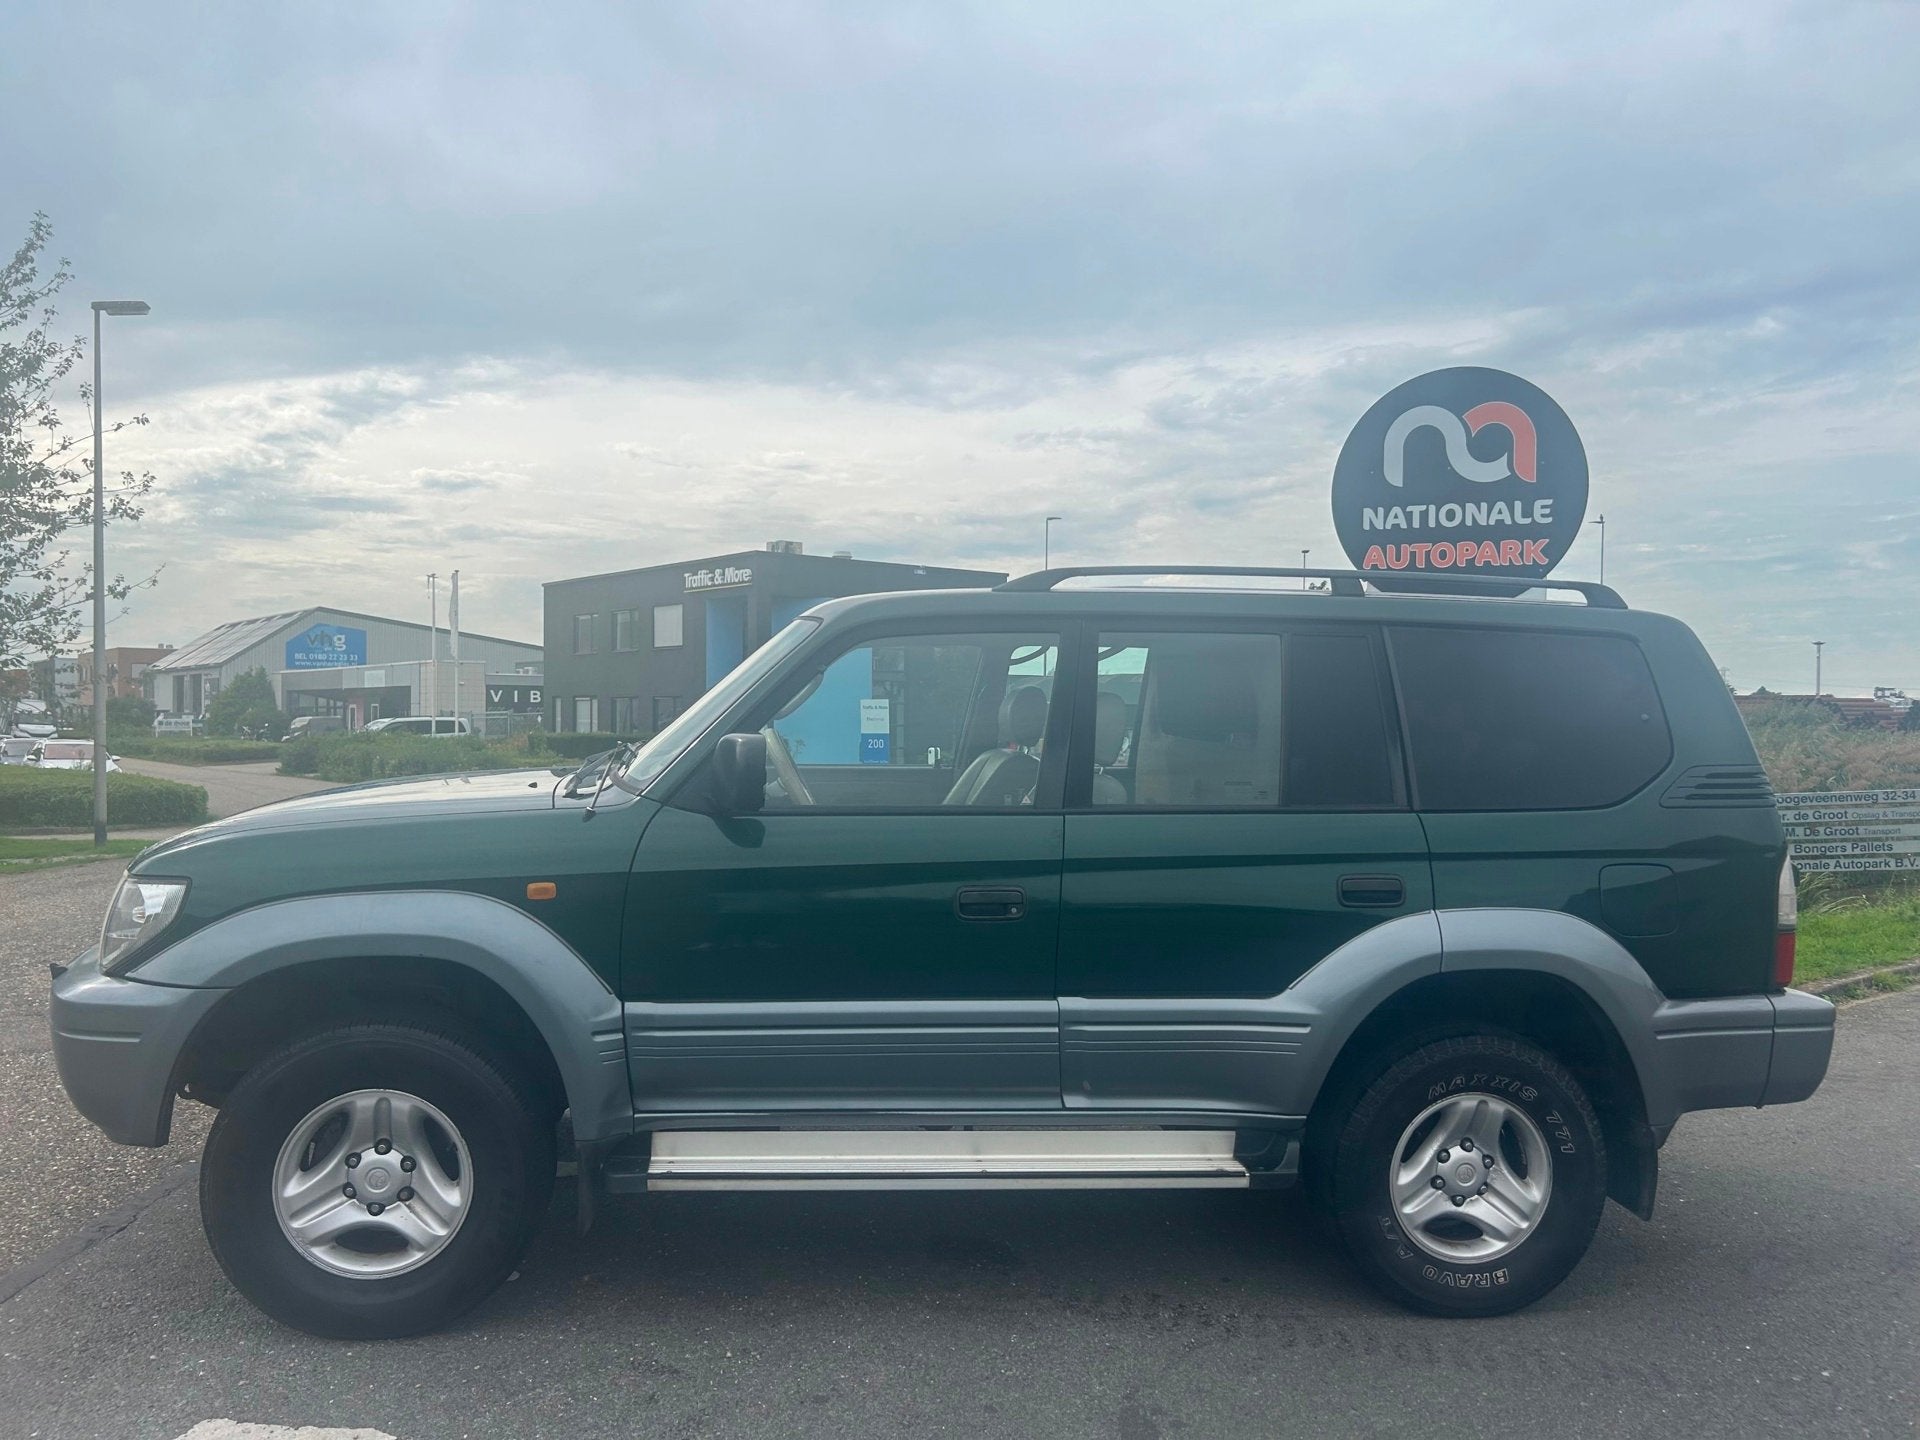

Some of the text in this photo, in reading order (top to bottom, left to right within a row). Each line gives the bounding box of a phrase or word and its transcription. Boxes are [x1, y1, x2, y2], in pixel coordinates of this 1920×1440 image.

[1362, 499, 1554, 531] NATIONALE
[1362, 538, 1550, 570] AUTOPARK
[684, 566, 753, 589] Traffic & More
[307, 630, 347, 651] vhg
[294, 652, 308, 660] BEL
[868, 738, 885, 749] 200
[1776, 790, 1916, 806] oogeveenenweg 32-34
[1793, 811, 1809, 821] de
[1812, 810, 1849, 820] Groot
[1881, 810, 1889, 818] &
[1785, 826, 1901, 838] M. De Groot Transport
[1793, 841, 1894, 855] Bongers Pallets
[1796, 858, 1919, 871] onale Autopark B.V.
[1428, 1074, 1576, 1154] MAXXIS 771
[1422, 1264, 1509, 1288] BRAVO
